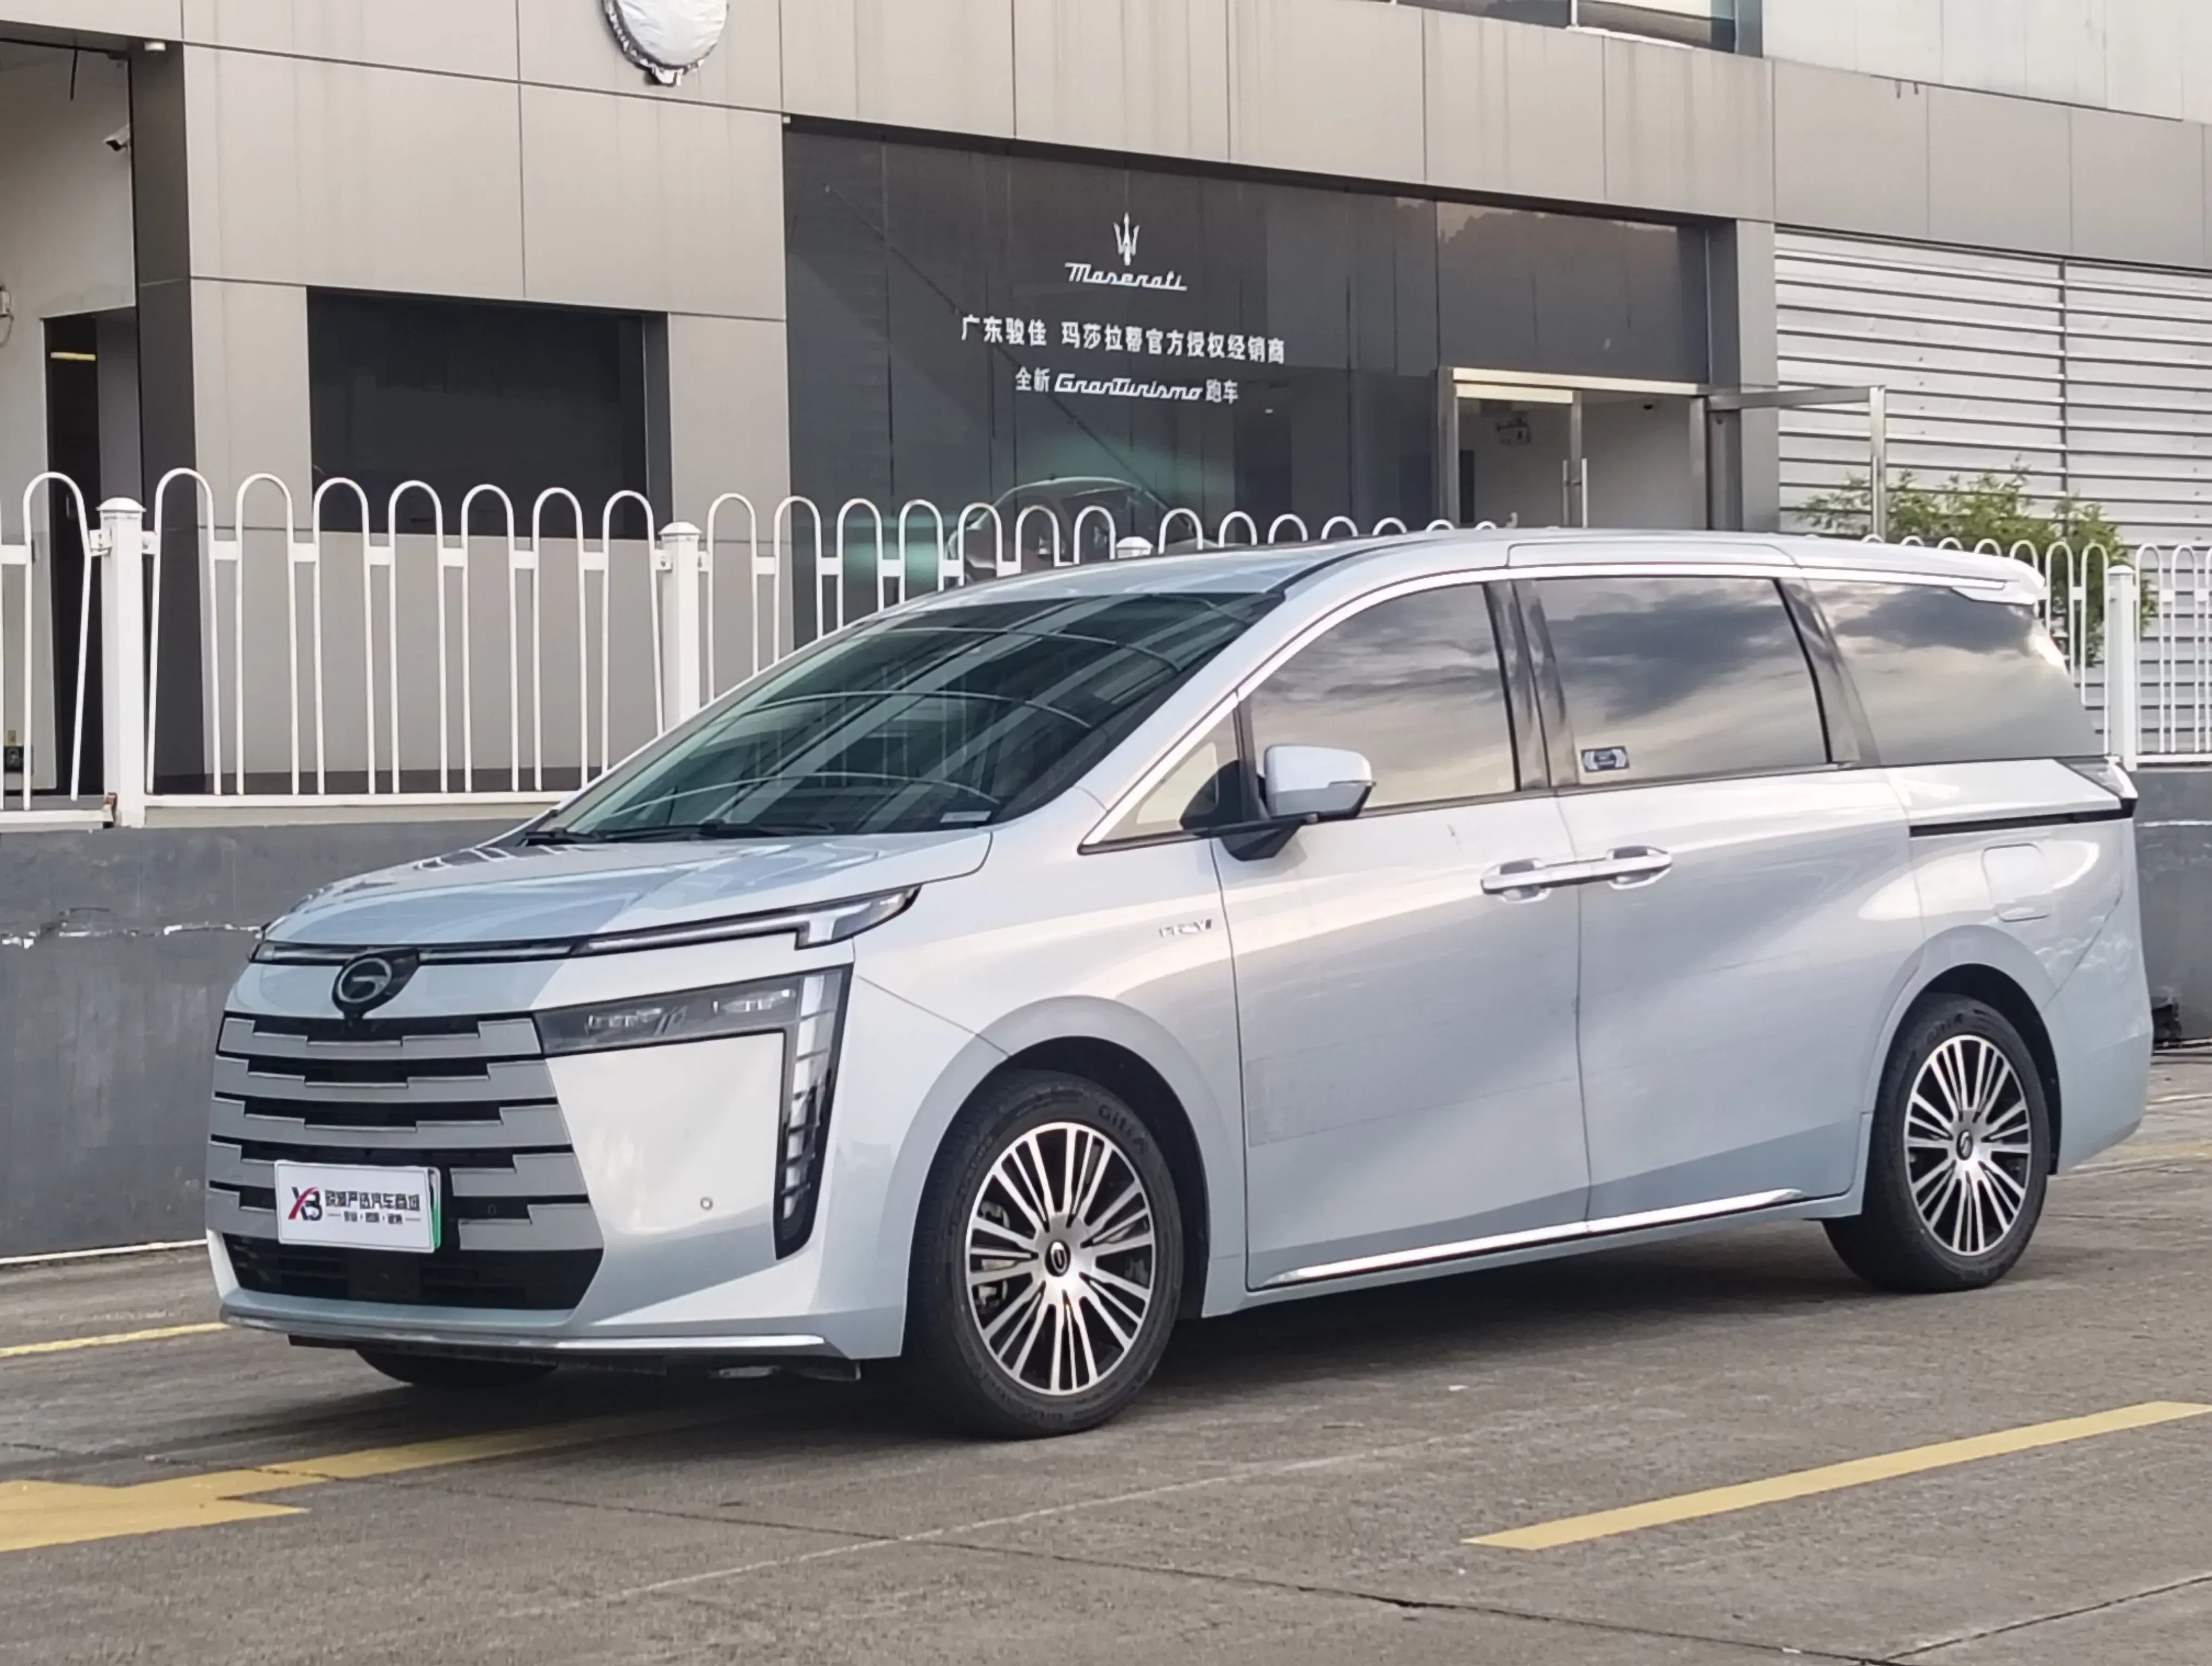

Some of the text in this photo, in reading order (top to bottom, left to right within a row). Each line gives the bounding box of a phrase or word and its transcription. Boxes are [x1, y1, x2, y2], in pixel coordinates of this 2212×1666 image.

[1064, 262, 1187, 291] Maserati
[961, 314, 1047, 347] 广东骏佳
[1015, 366, 1050, 392] 全新
[1205, 379, 1239, 404] 跑车
